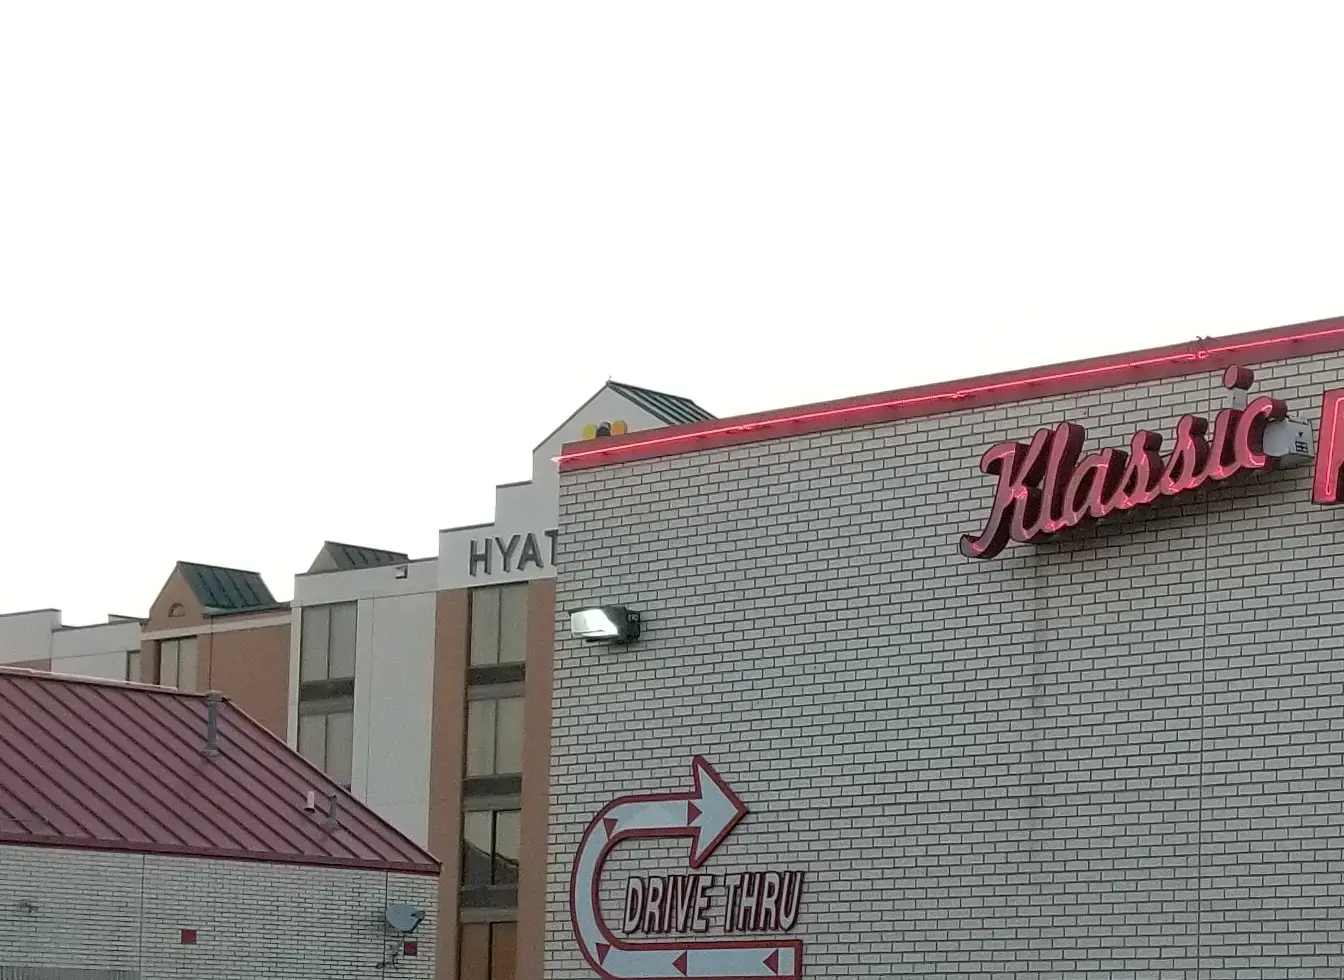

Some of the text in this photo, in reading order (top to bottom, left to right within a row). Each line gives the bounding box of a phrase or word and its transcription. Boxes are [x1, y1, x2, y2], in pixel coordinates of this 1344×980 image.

[960, 364, 1288, 559] Klassic
[623, 870, 804, 934] DRIVE THRU
